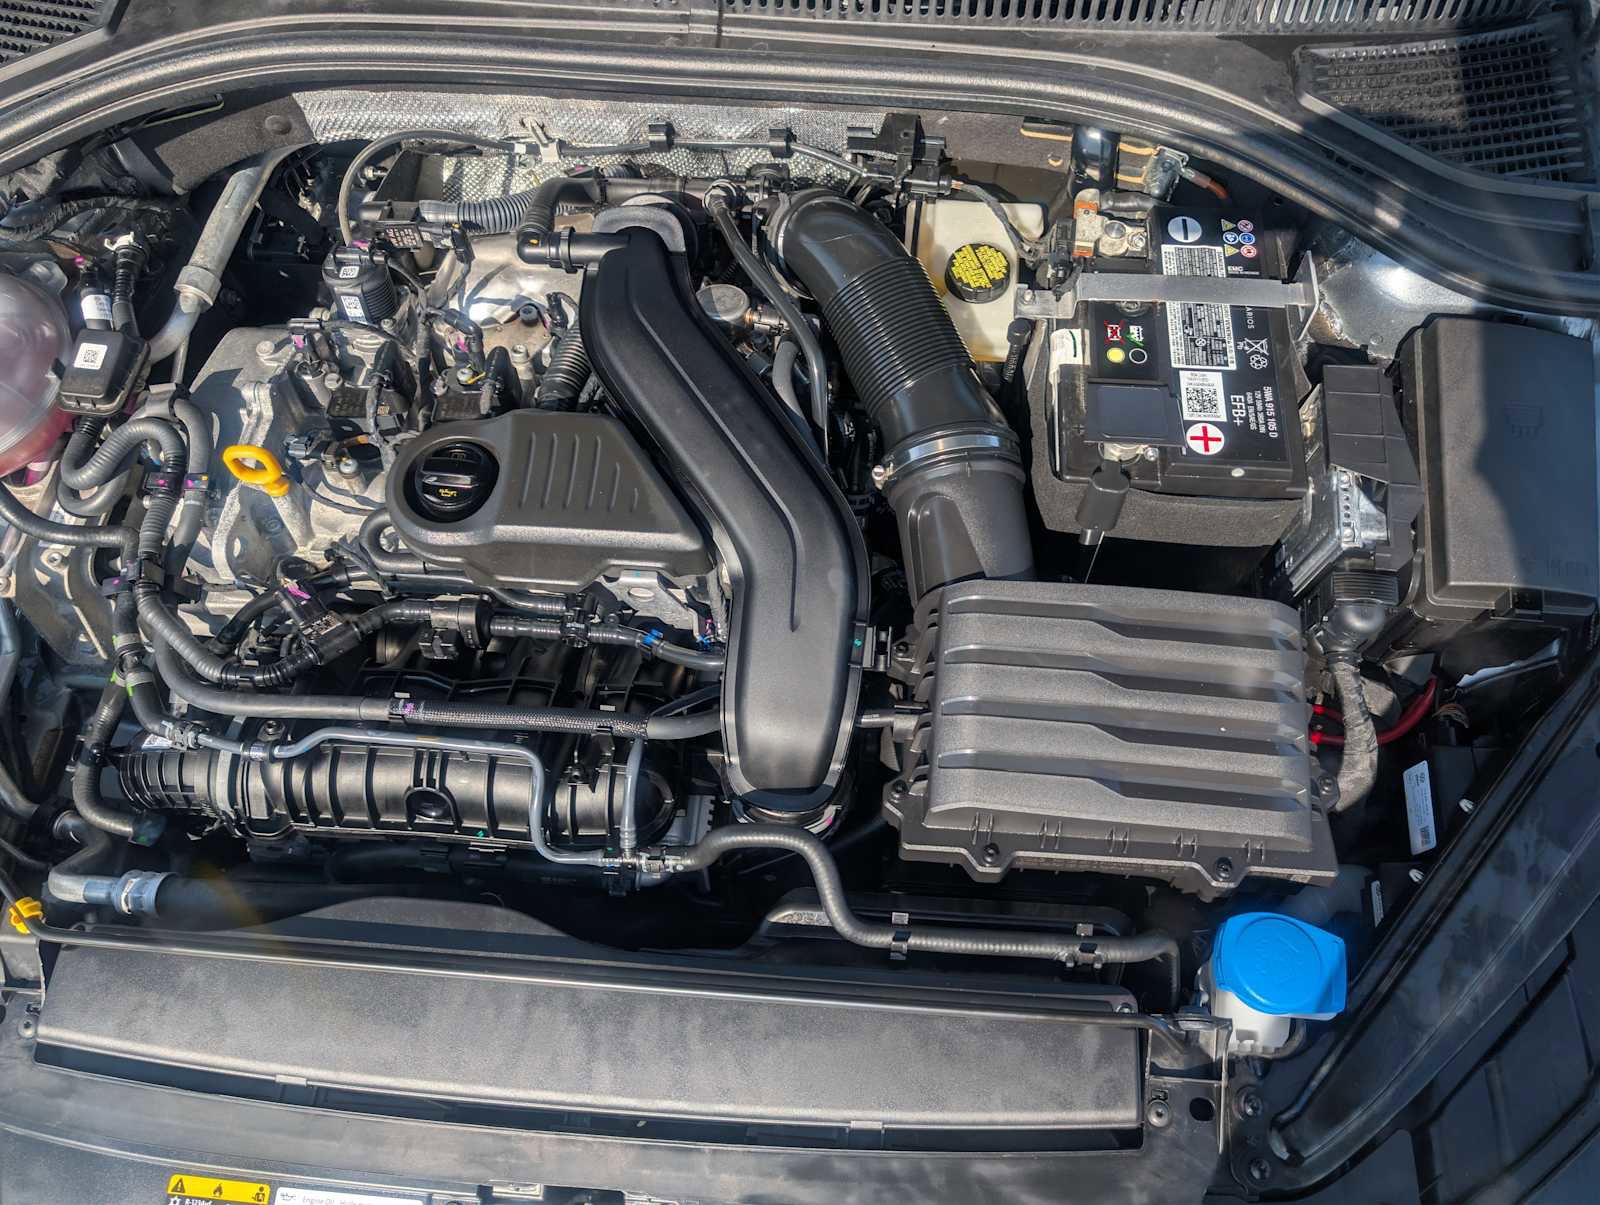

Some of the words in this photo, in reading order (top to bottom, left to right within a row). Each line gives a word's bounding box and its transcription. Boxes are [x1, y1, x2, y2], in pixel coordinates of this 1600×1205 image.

[1245, 305, 1254, 329] ARIOS
[1263, 386, 1273, 402] 5WA
[1231, 394, 1246, 426] EFB+
[1265, 403, 1275, 416] 915
[1267, 418, 1277, 431] 105
